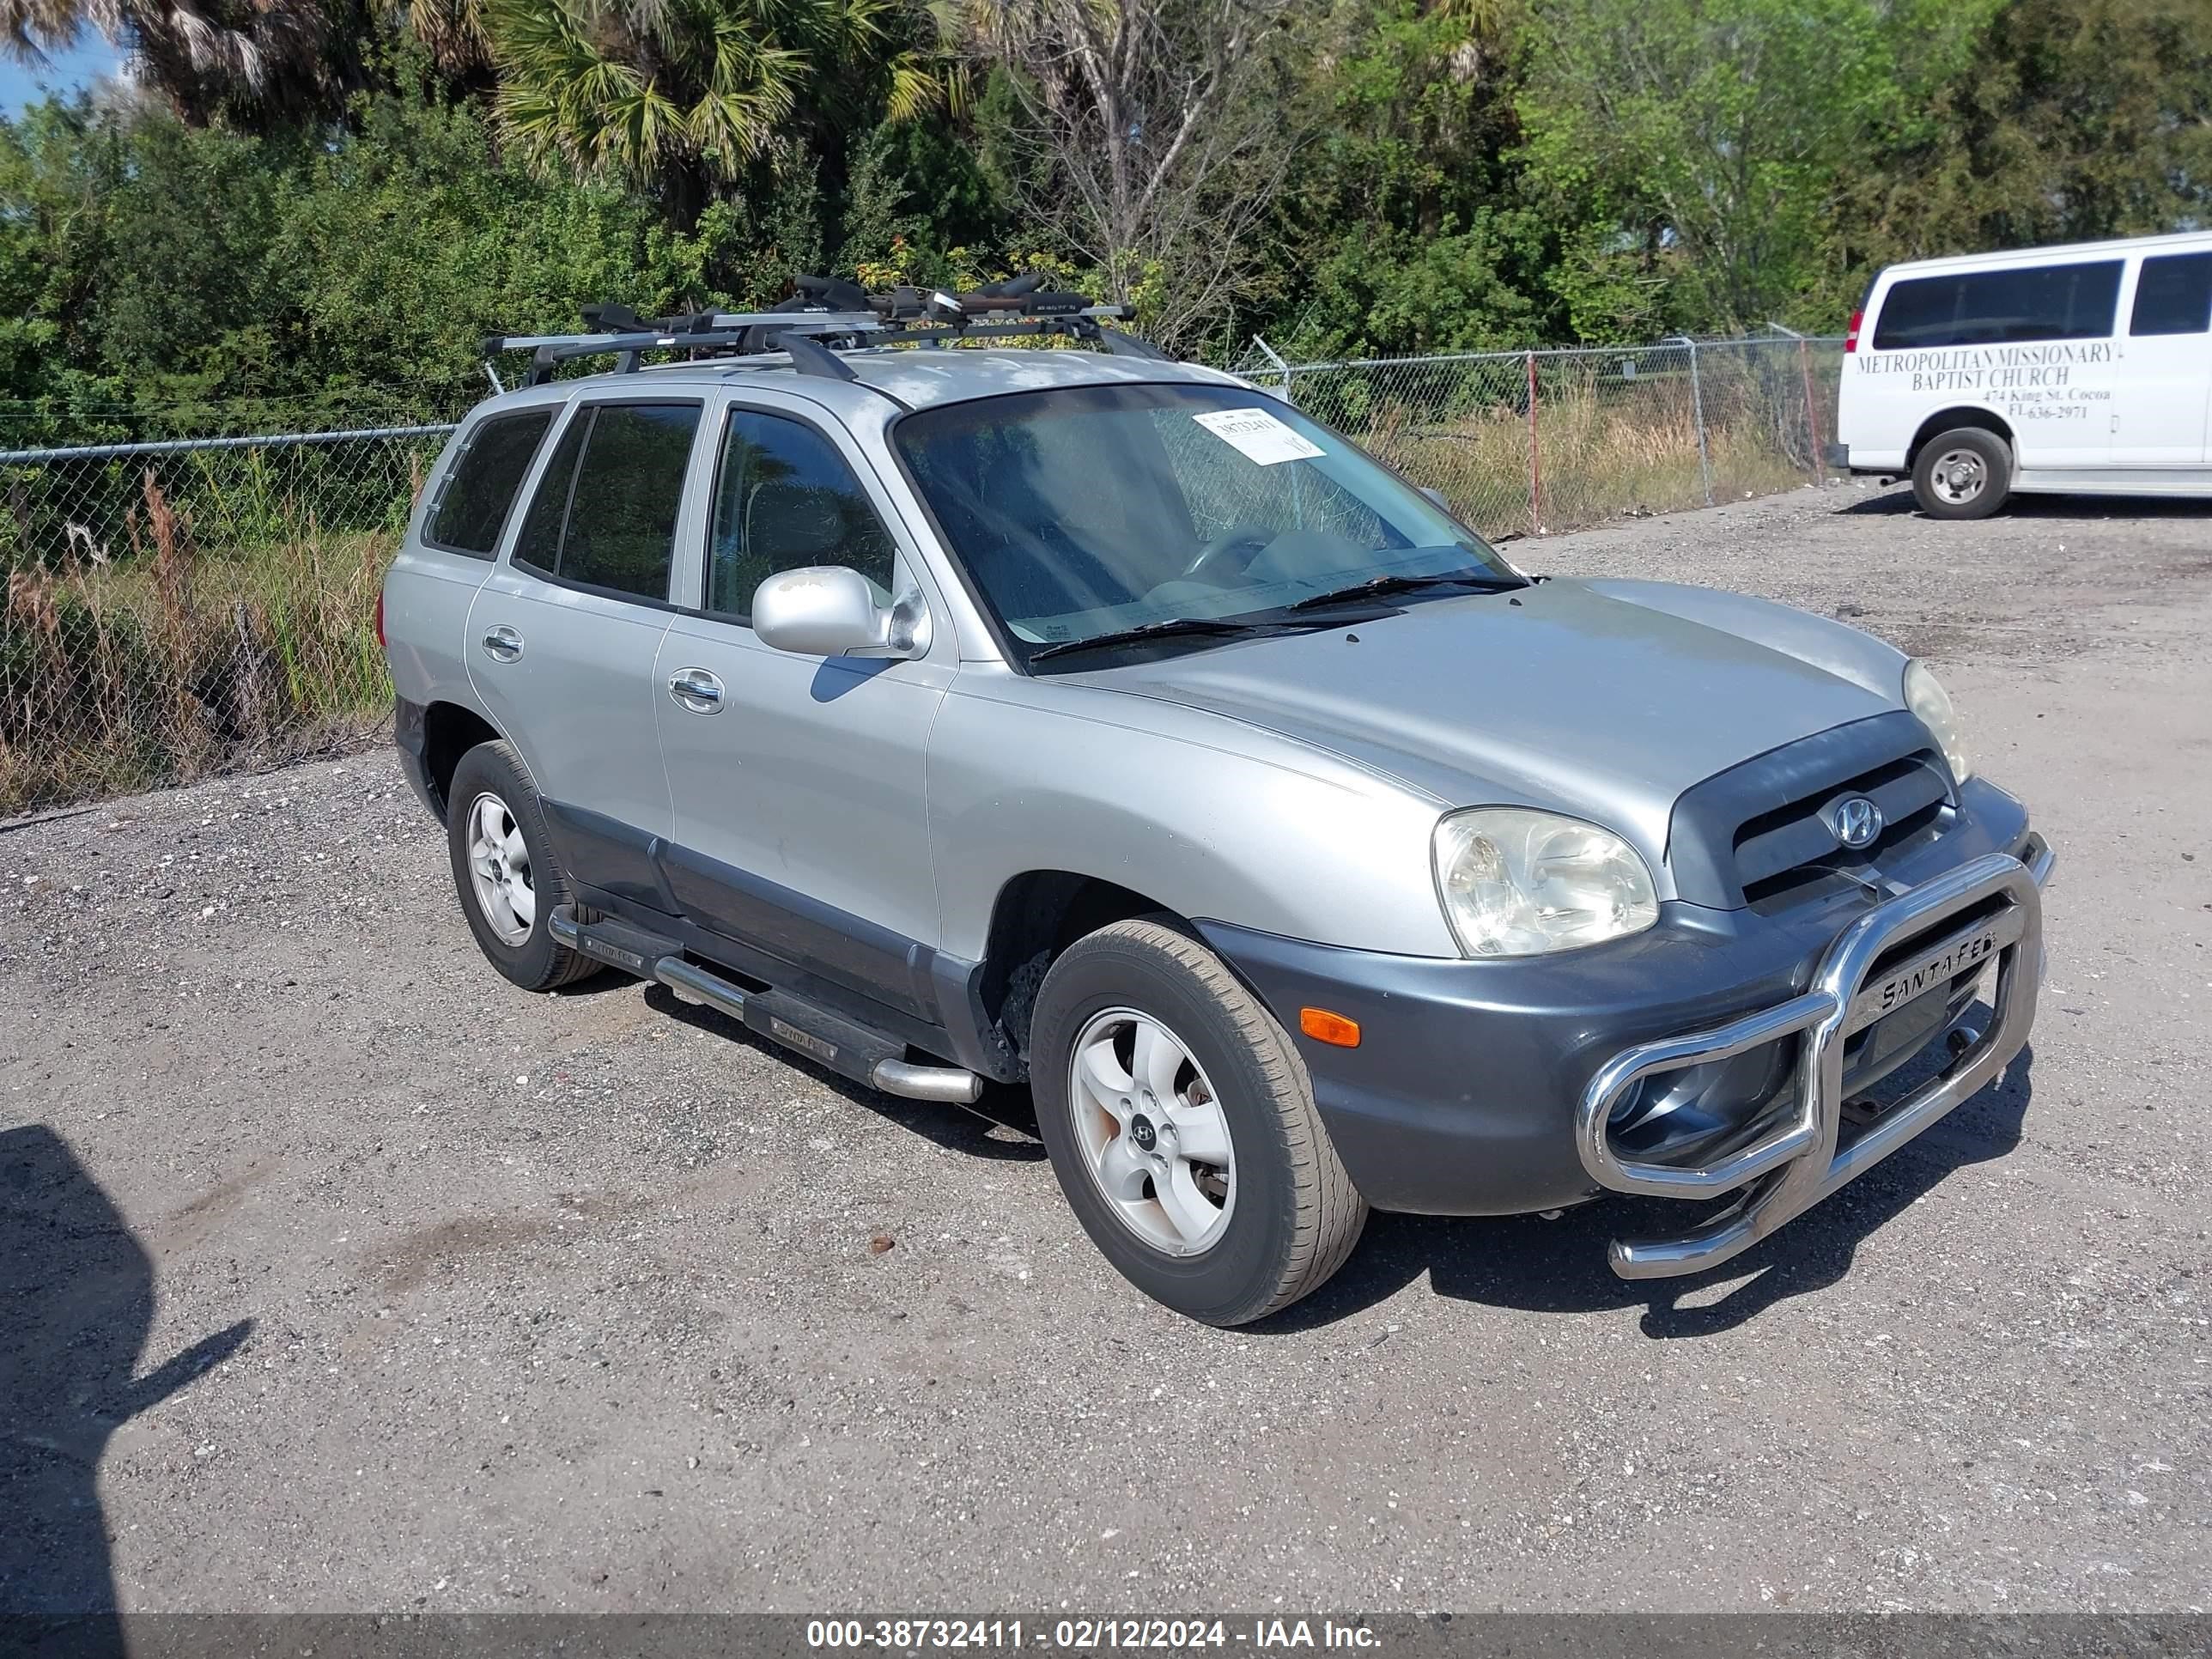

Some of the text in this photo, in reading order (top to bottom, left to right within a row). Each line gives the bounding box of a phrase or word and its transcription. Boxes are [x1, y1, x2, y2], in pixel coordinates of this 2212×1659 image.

[1857, 343, 2116, 374] METROPOLITAN MISSIONARY
[1912, 366, 2069, 391] BAPTIST CHURCH
[1984, 390, 2006, 403] 474
[2010, 389, 2043, 403] King
[2068, 387, 2111, 401] Cocoa
[1216, 419, 1277, 435] 38732411
